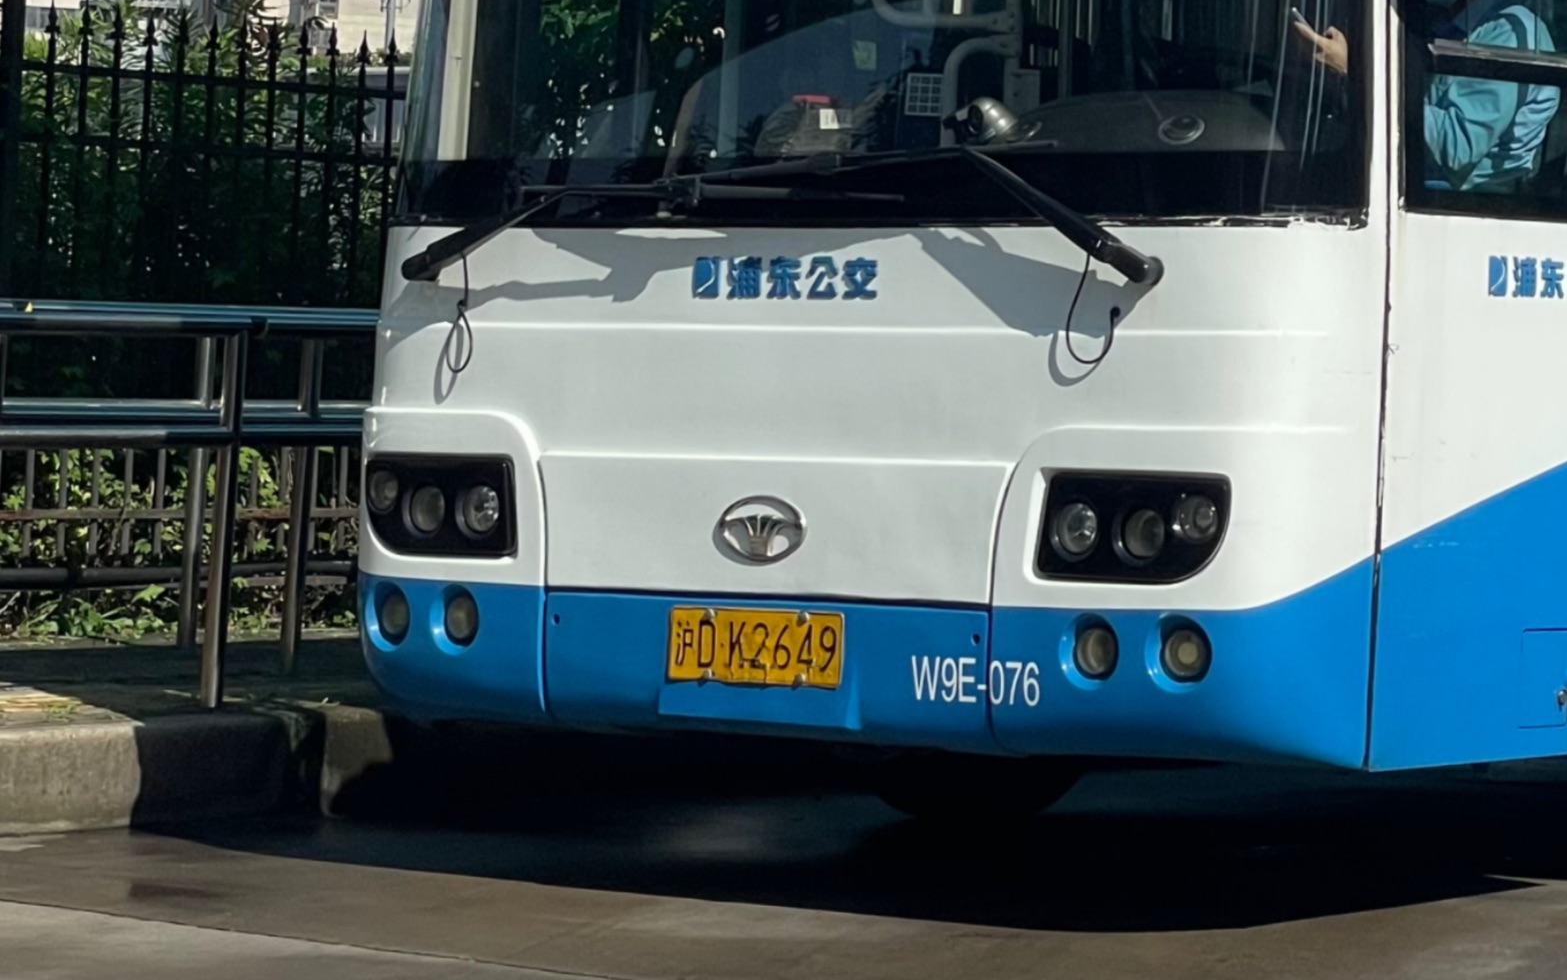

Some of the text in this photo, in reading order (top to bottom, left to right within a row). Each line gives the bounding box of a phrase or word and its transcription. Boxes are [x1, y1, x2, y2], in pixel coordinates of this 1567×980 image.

[726, 256, 879, 300] 浦东公交
[911, 655, 1041, 707] W9E-076
